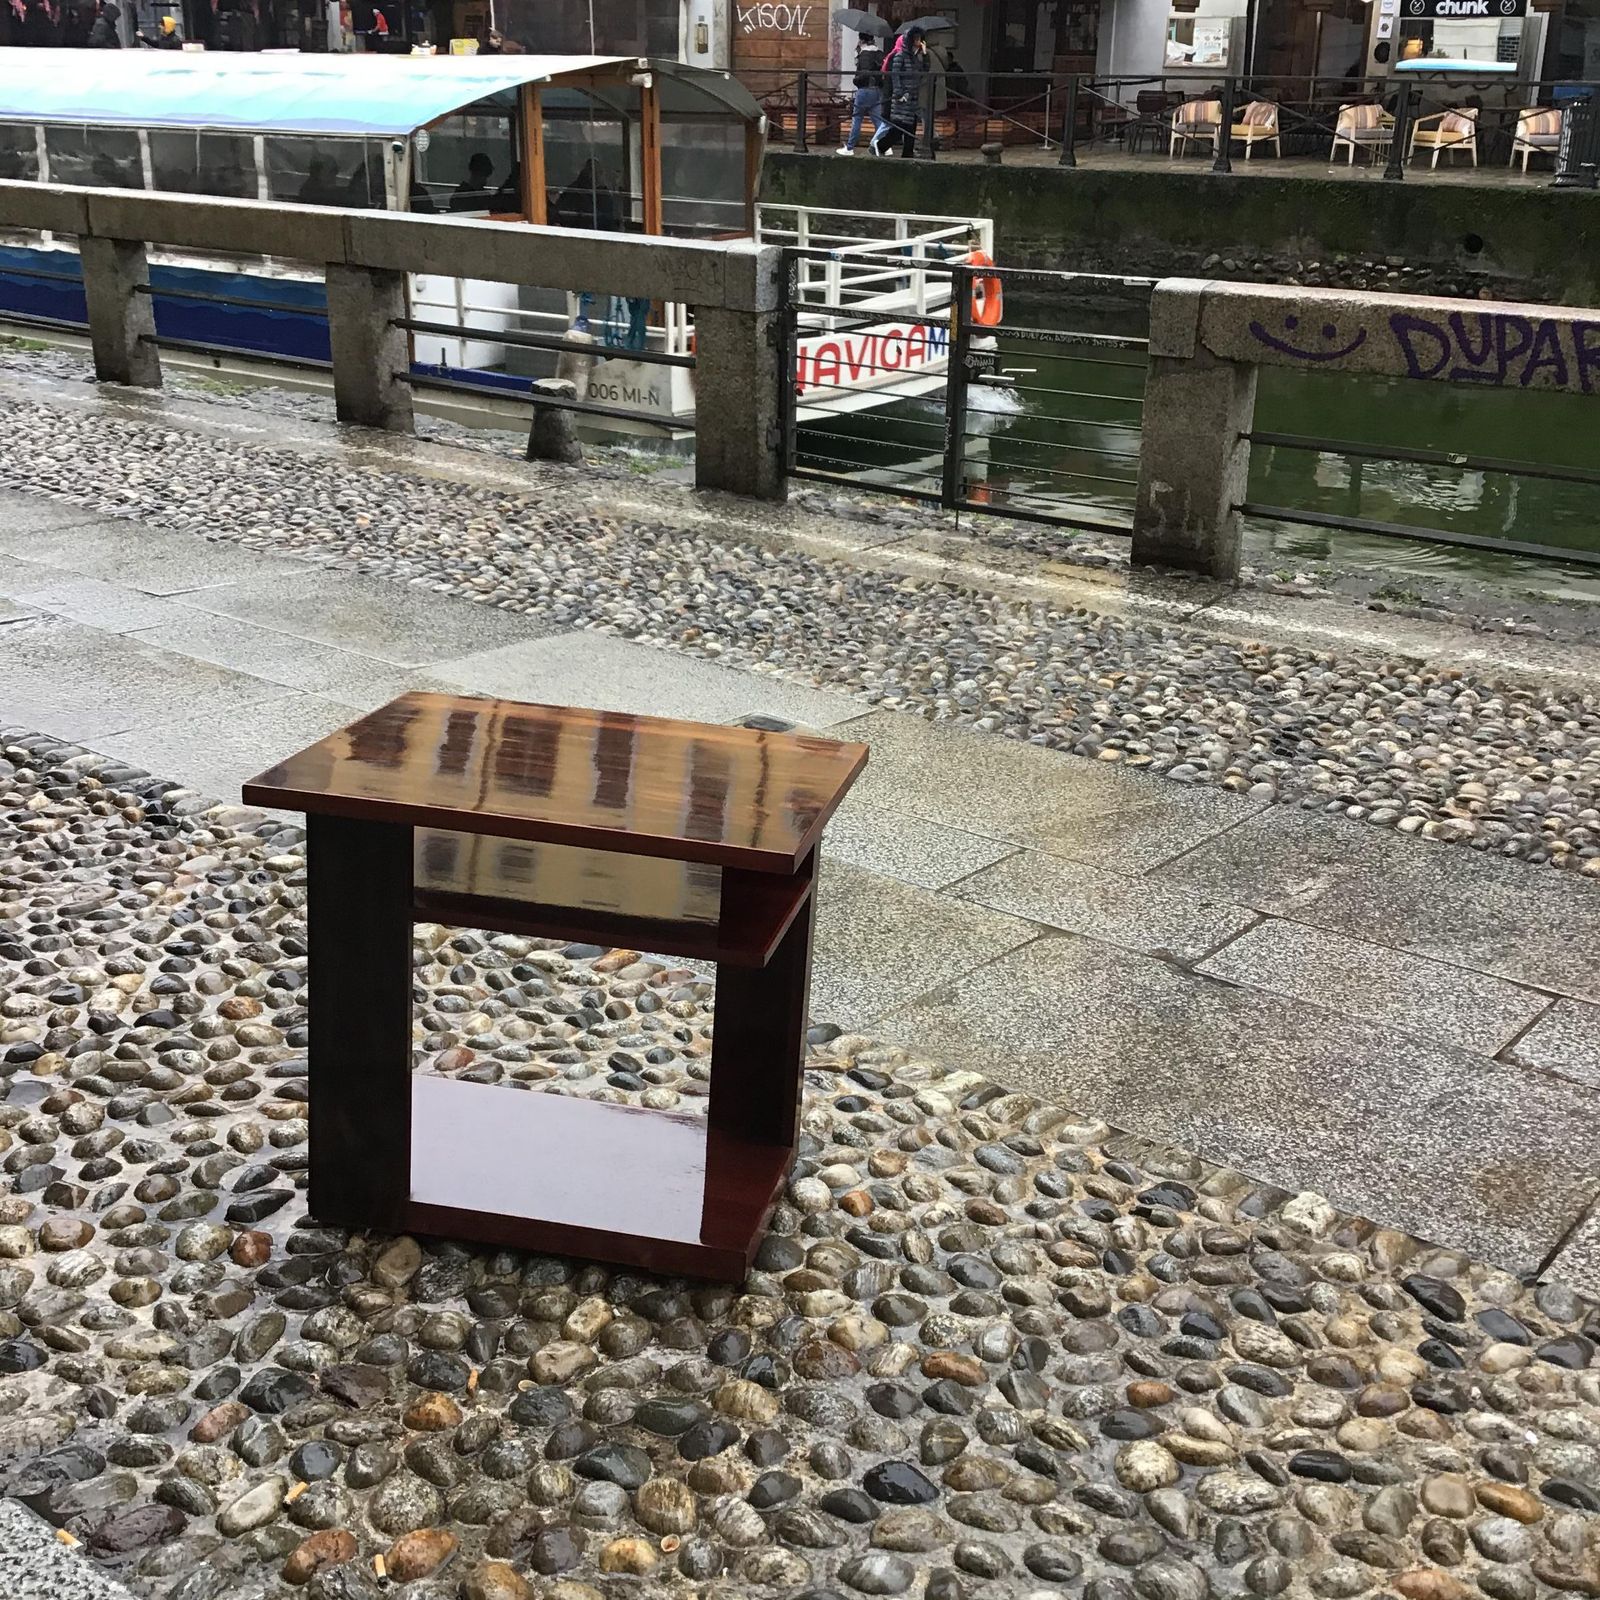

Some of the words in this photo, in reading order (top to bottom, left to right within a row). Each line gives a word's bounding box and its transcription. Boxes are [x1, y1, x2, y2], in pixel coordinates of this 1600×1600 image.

[1436, 0, 1489, 15] chunk
[588, 382, 618, 401] 006
[622, 386, 660, 406] MI-N
